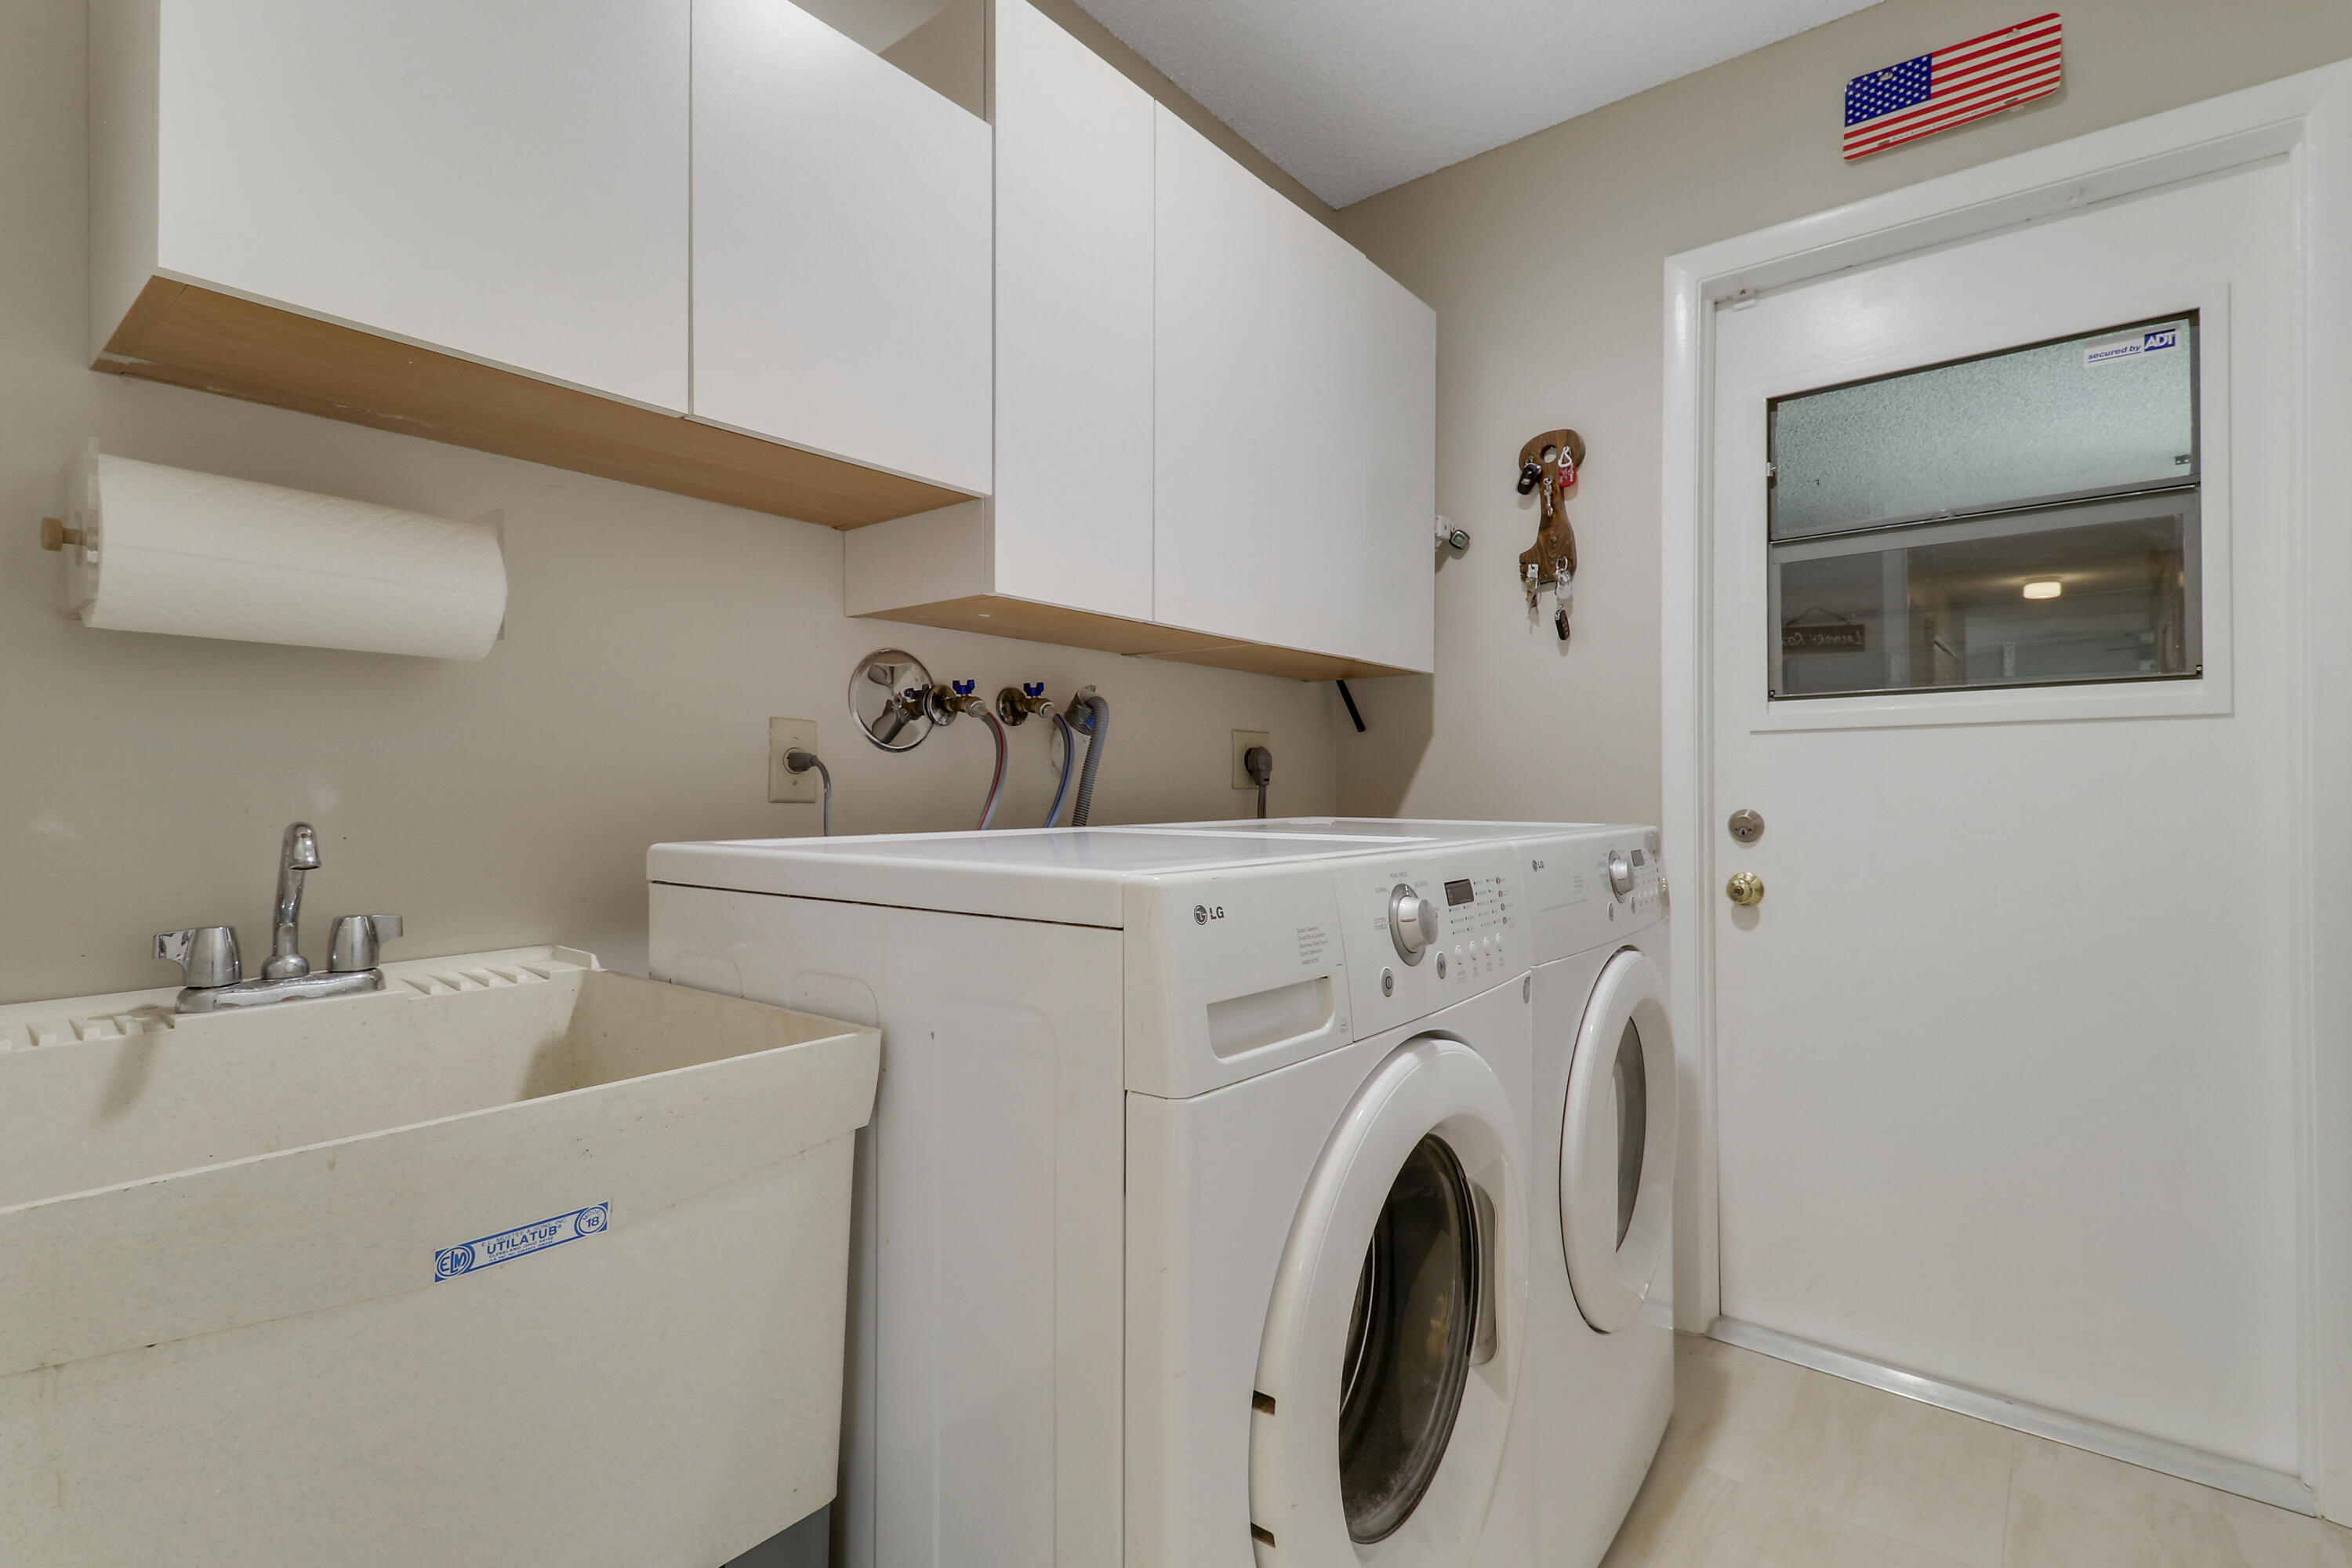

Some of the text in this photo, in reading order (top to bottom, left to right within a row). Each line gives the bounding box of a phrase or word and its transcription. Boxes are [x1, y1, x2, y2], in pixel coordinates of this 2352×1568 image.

[2088, 346, 2128, 359] secured
[2144, 331, 2176, 350] ADT
[1209, 906, 1225, 920] LG
[586, 1216, 600, 1228] 18
[495, 1230, 524, 1242] MUSTEE
[439, 1250, 467, 1274] ELM
